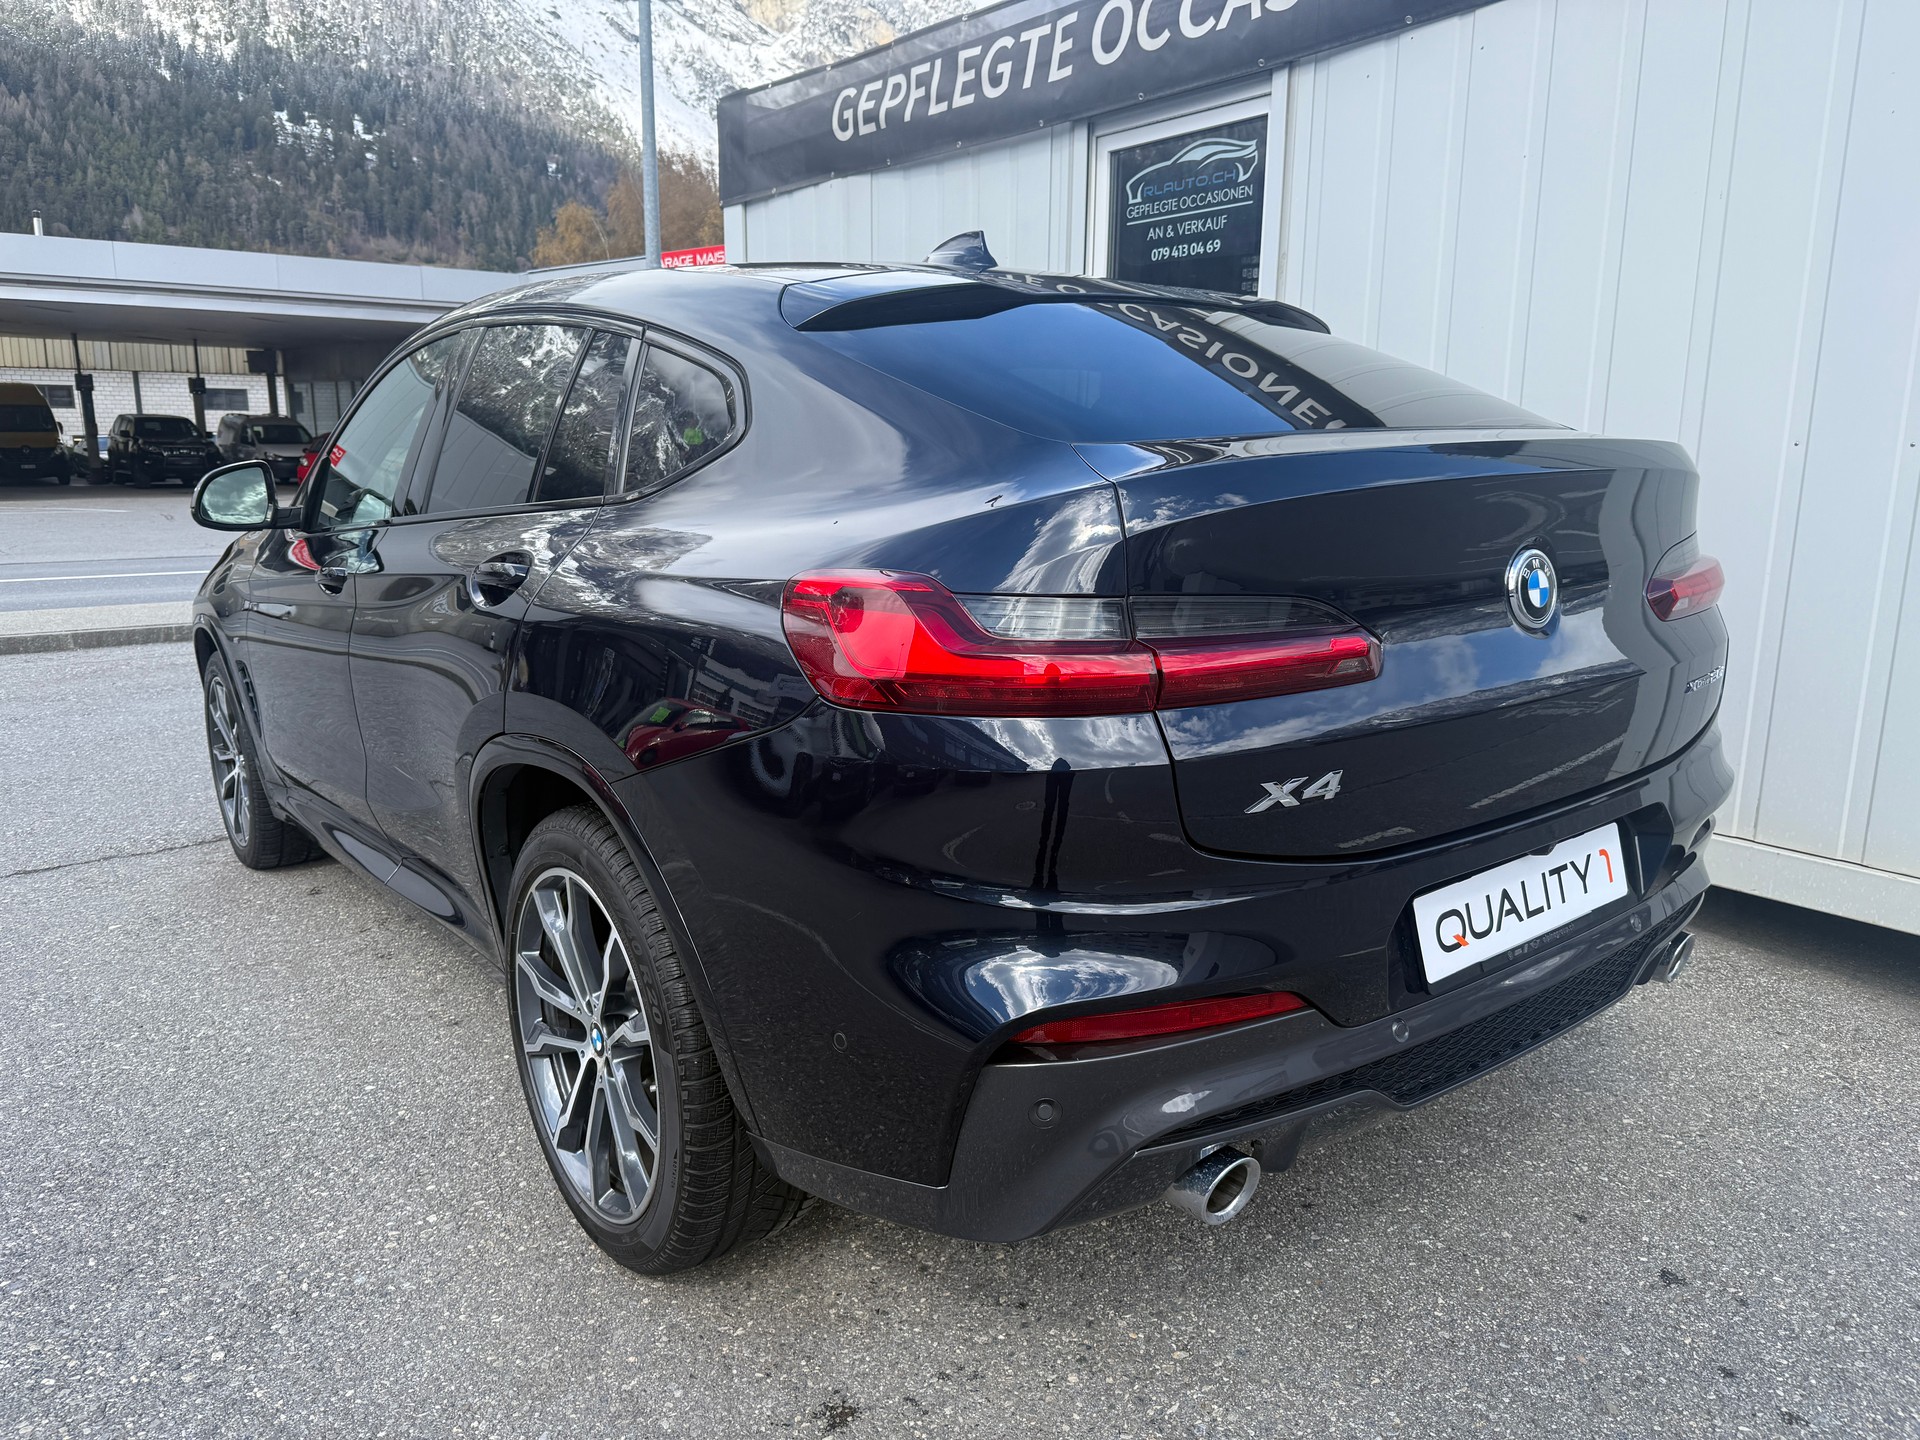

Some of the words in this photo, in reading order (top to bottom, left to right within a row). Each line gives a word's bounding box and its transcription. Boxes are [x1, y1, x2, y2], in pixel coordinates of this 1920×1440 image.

[832, 11, 1079, 141] GEPFLEGTE
[1091, 0, 1297, 65] OCC
[1143, 169, 1236, 197] RLAUTO.CH
[1126, 198, 1179, 218] GEPFLEGTE
[1180, 184, 1254, 209] OCCASIONEN
[1147, 226, 1163, 241] AN
[1166, 225, 1174, 238] &
[1177, 215, 1228, 236] VERKAUF
[1151, 247, 1170, 261] 079
[1171, 244, 1189, 258] 413
[1190, 241, 1205, 256] 04
[1206, 239, 1221, 253] 69
[1243, 769, 1344, 814] X4
